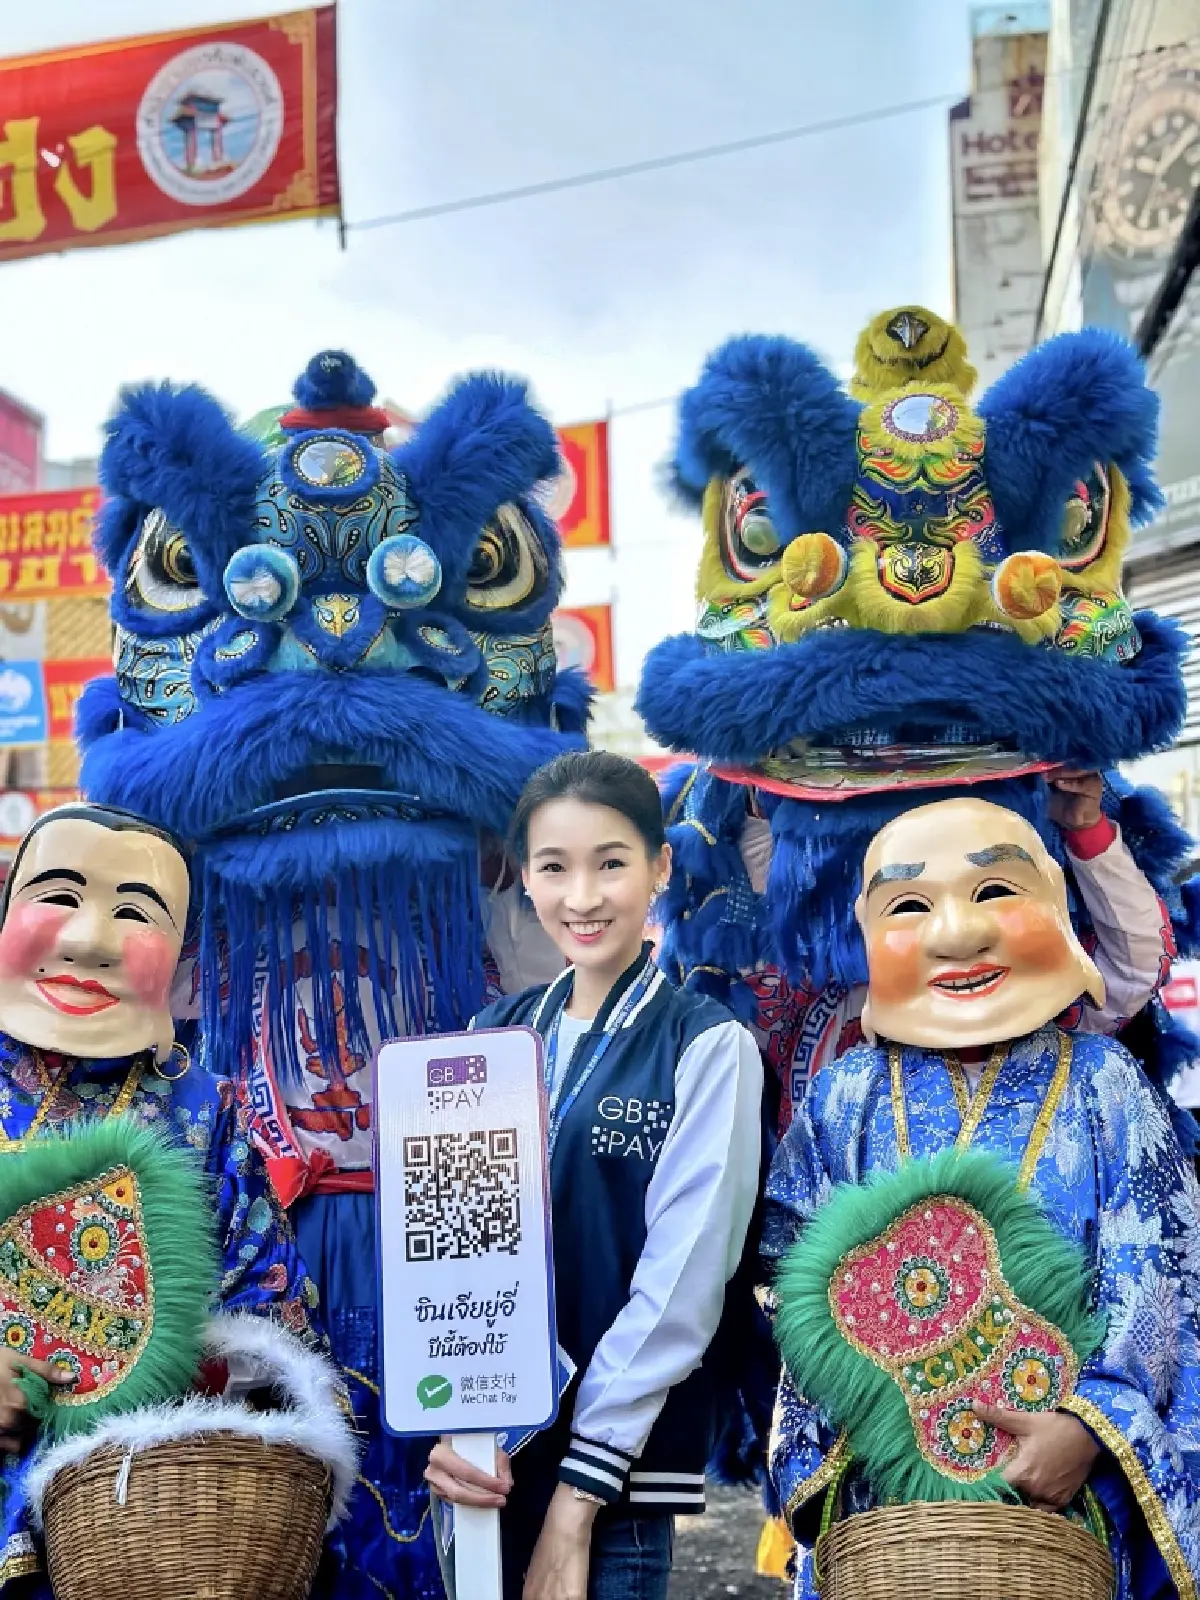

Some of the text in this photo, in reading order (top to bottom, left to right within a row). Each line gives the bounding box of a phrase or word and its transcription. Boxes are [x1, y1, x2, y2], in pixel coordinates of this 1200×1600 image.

[429, 1066, 454, 1084] GB
[441, 1086, 485, 1110] PAY
[598, 1096, 642, 1124] GB
[608, 1130, 662, 1162] PAY
[414, 1280, 520, 1329] ซินเจียยู่อี่
[428, 1329, 509, 1359] ปีนี้ต้องใช้
[460, 1372, 517, 1392] 微信支付
[460, 1391, 518, 1404] WeChat Pay
